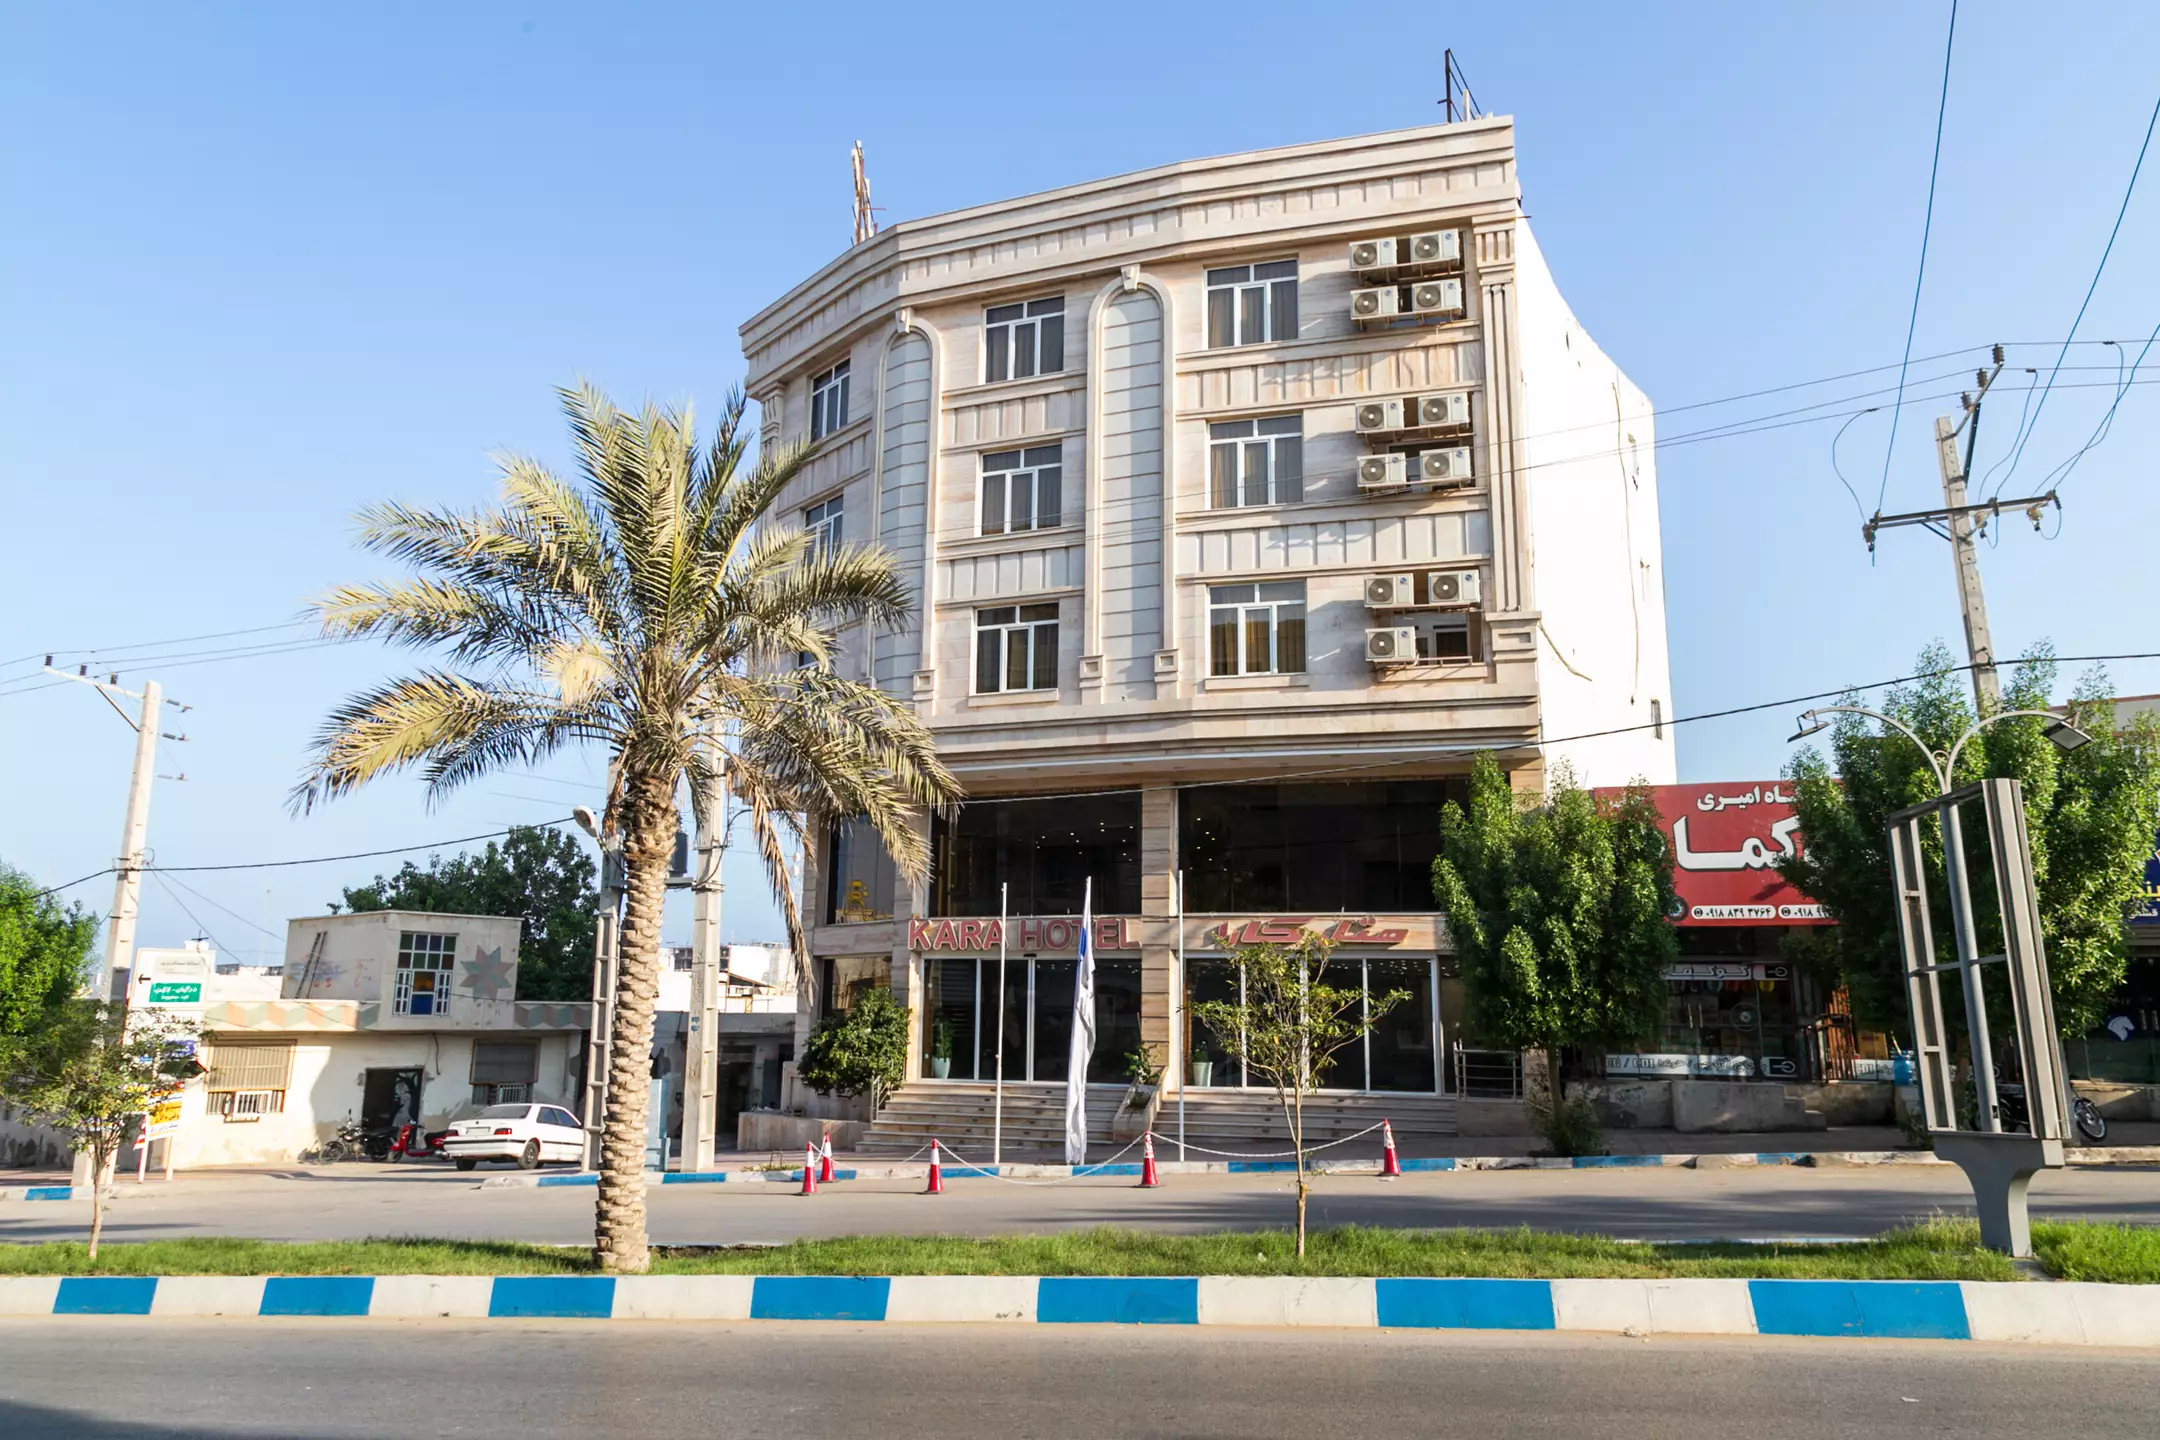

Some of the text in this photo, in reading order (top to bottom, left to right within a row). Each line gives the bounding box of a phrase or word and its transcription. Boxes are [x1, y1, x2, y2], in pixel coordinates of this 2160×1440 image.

[1696, 783, 1761, 812] امیری
[907, 919, 1009, 950] KARA
[1329, 914, 1410, 943] هتل
